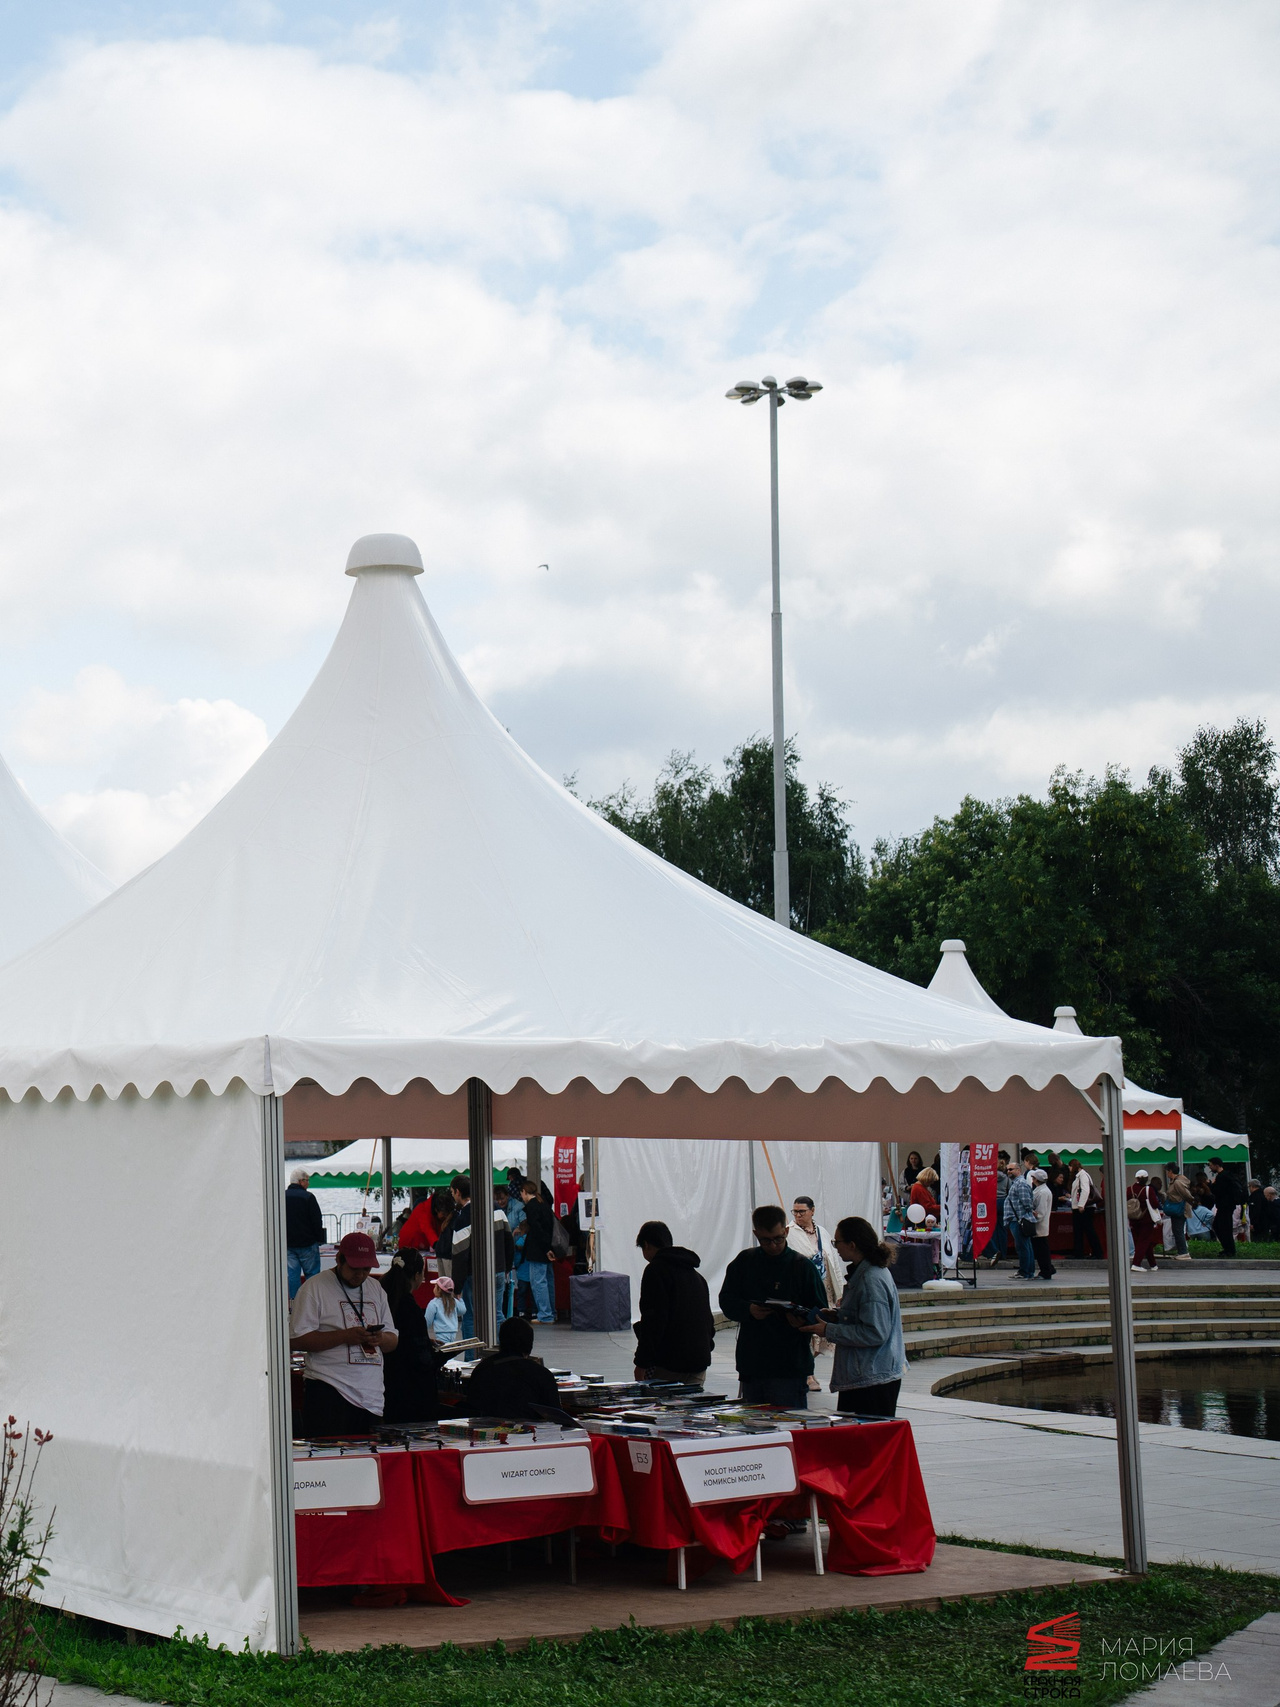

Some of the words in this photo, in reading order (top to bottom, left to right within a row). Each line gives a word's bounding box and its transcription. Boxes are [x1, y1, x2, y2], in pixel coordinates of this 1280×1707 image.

[636, 1452, 649, 1464] Б3
[501, 1470, 528, 1479] WIZART
[529, 1468, 556, 1477] COMICS
[704, 1467, 727, 1476] MOLOT
[728, 1463, 763, 1474] HARDCORP
[293, 1480, 327, 1490] ДОРАМА
[703, 1477, 737, 1487] КОМИКСЫ
[738, 1473, 766, 1483] МОЛОТА
